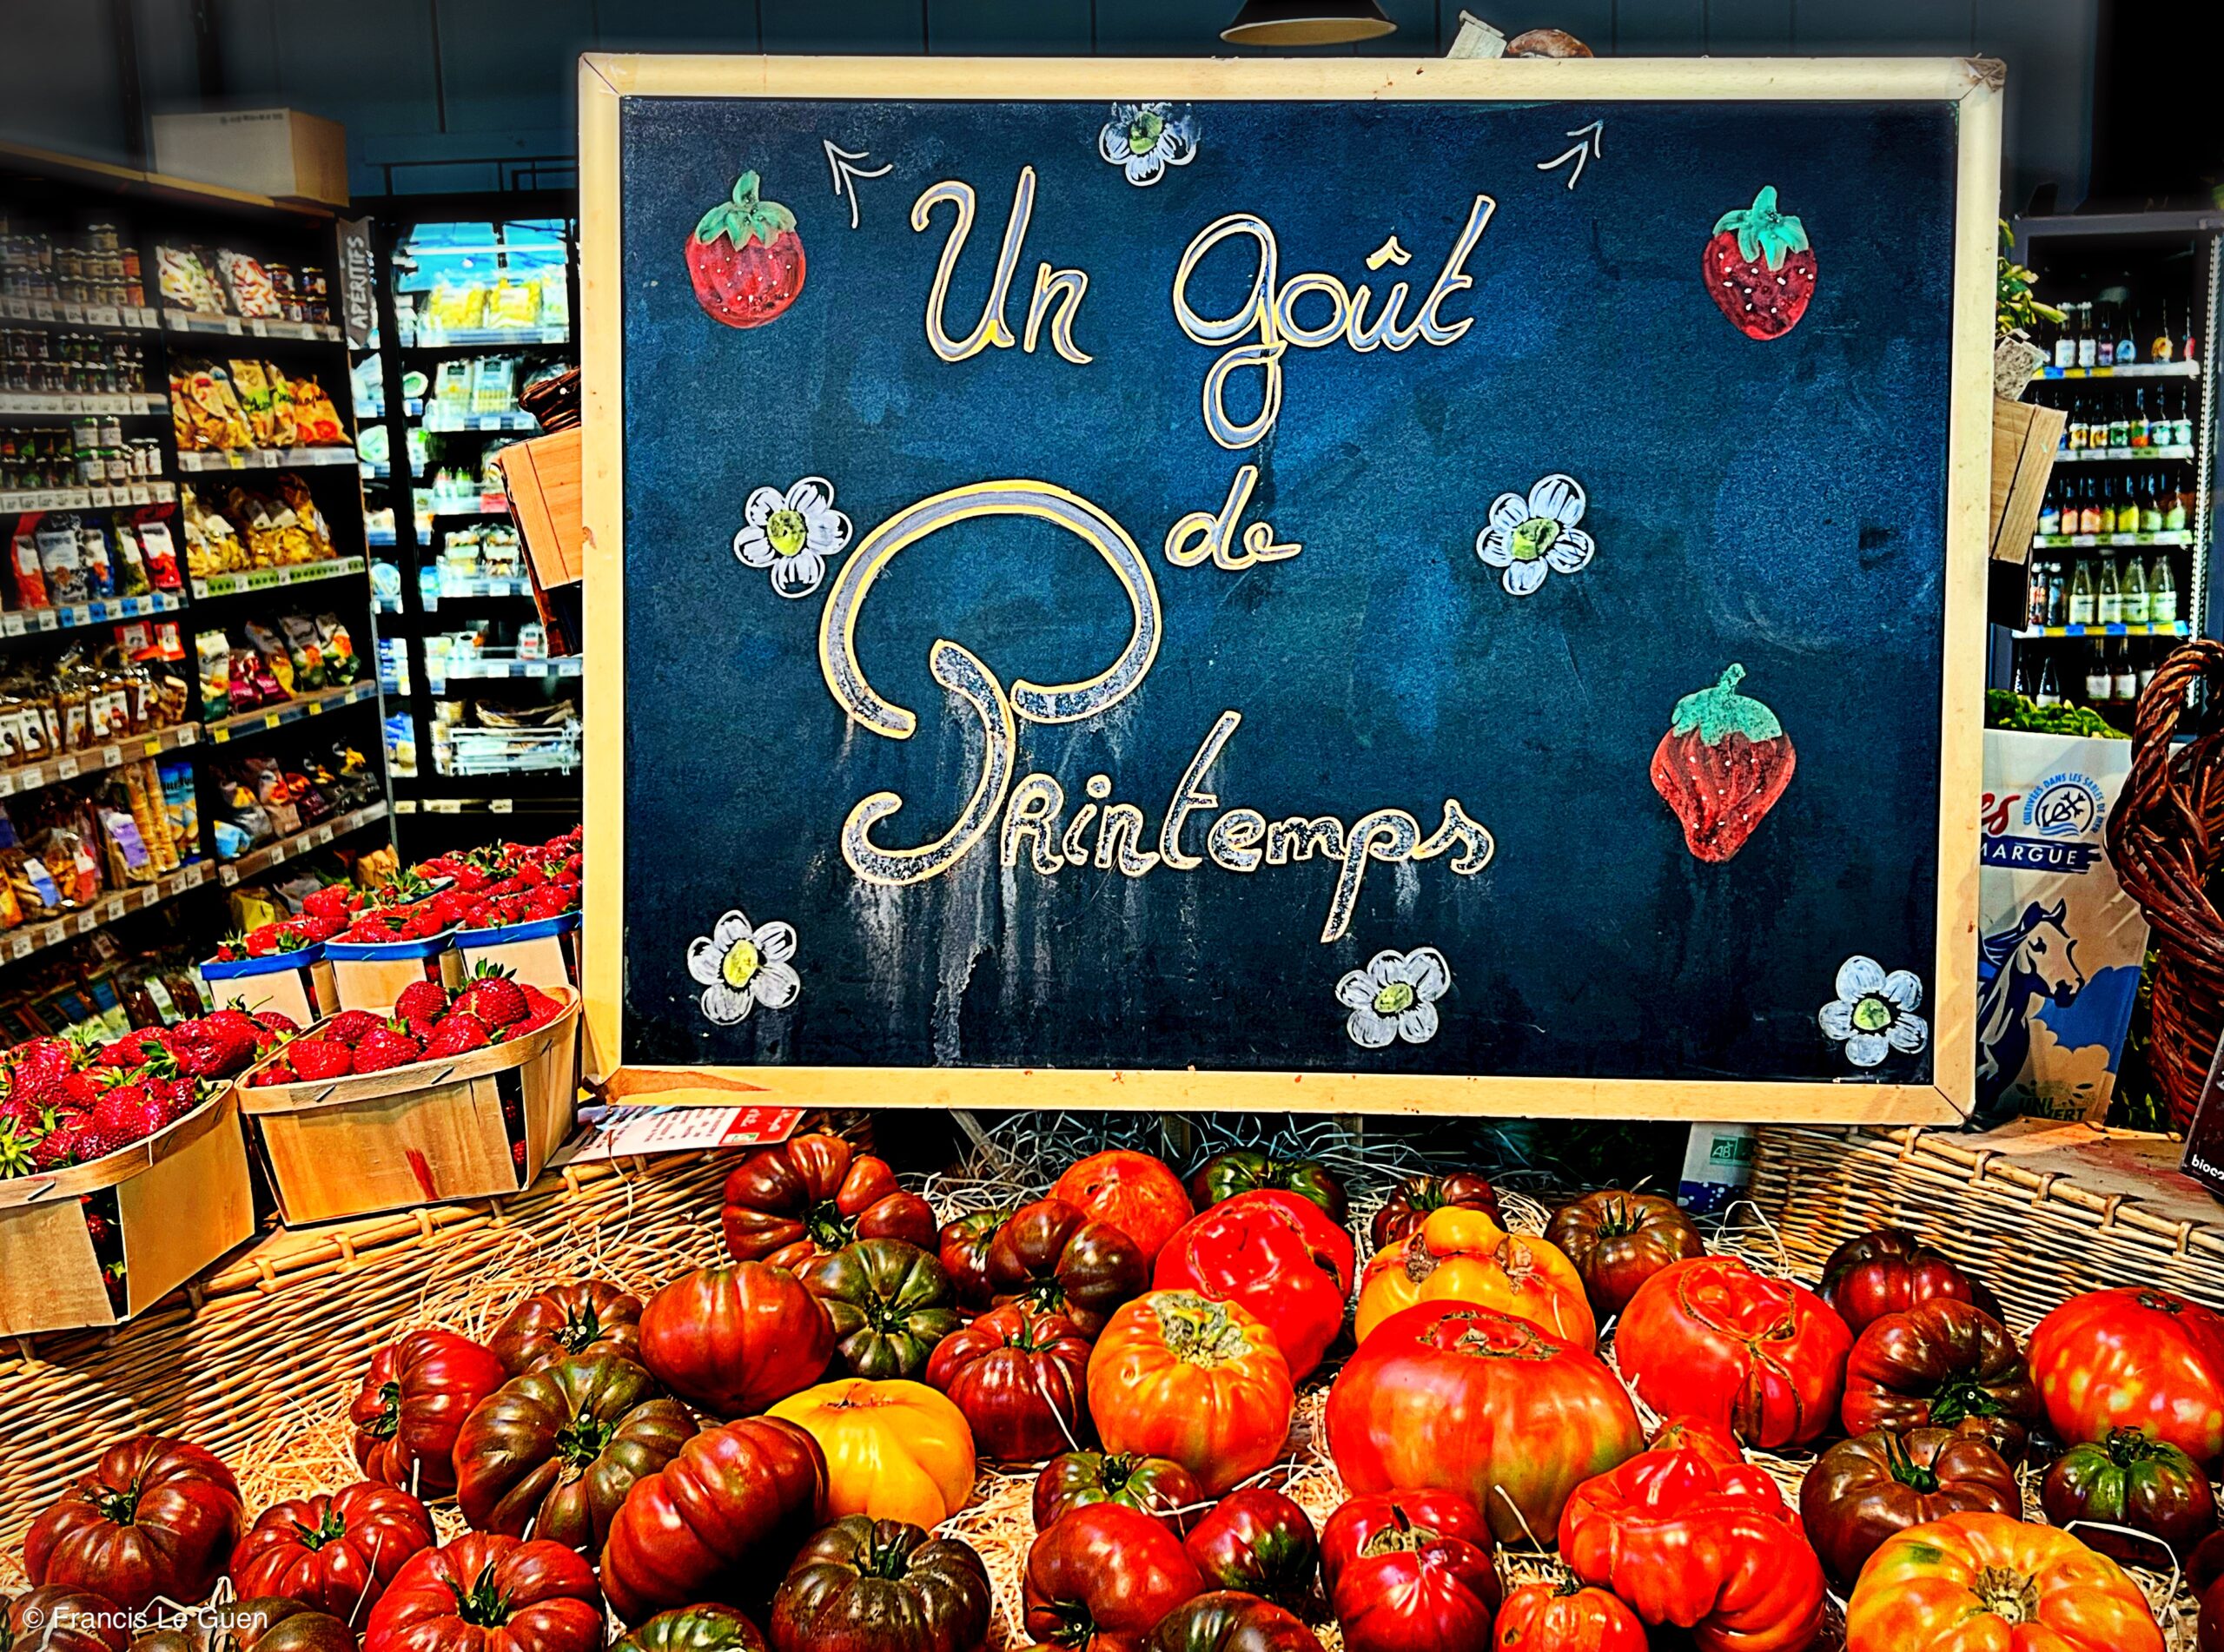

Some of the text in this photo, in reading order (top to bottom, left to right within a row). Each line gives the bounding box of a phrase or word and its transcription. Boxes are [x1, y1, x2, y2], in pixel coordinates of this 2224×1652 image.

[910, 166, 1496, 449] Un goût
[1164, 465, 1302, 570] de
[2042, 771, 2067, 789] DANS
[2068, 771, 2083, 783] LES
[2082, 776, 2105, 802] SABLES
